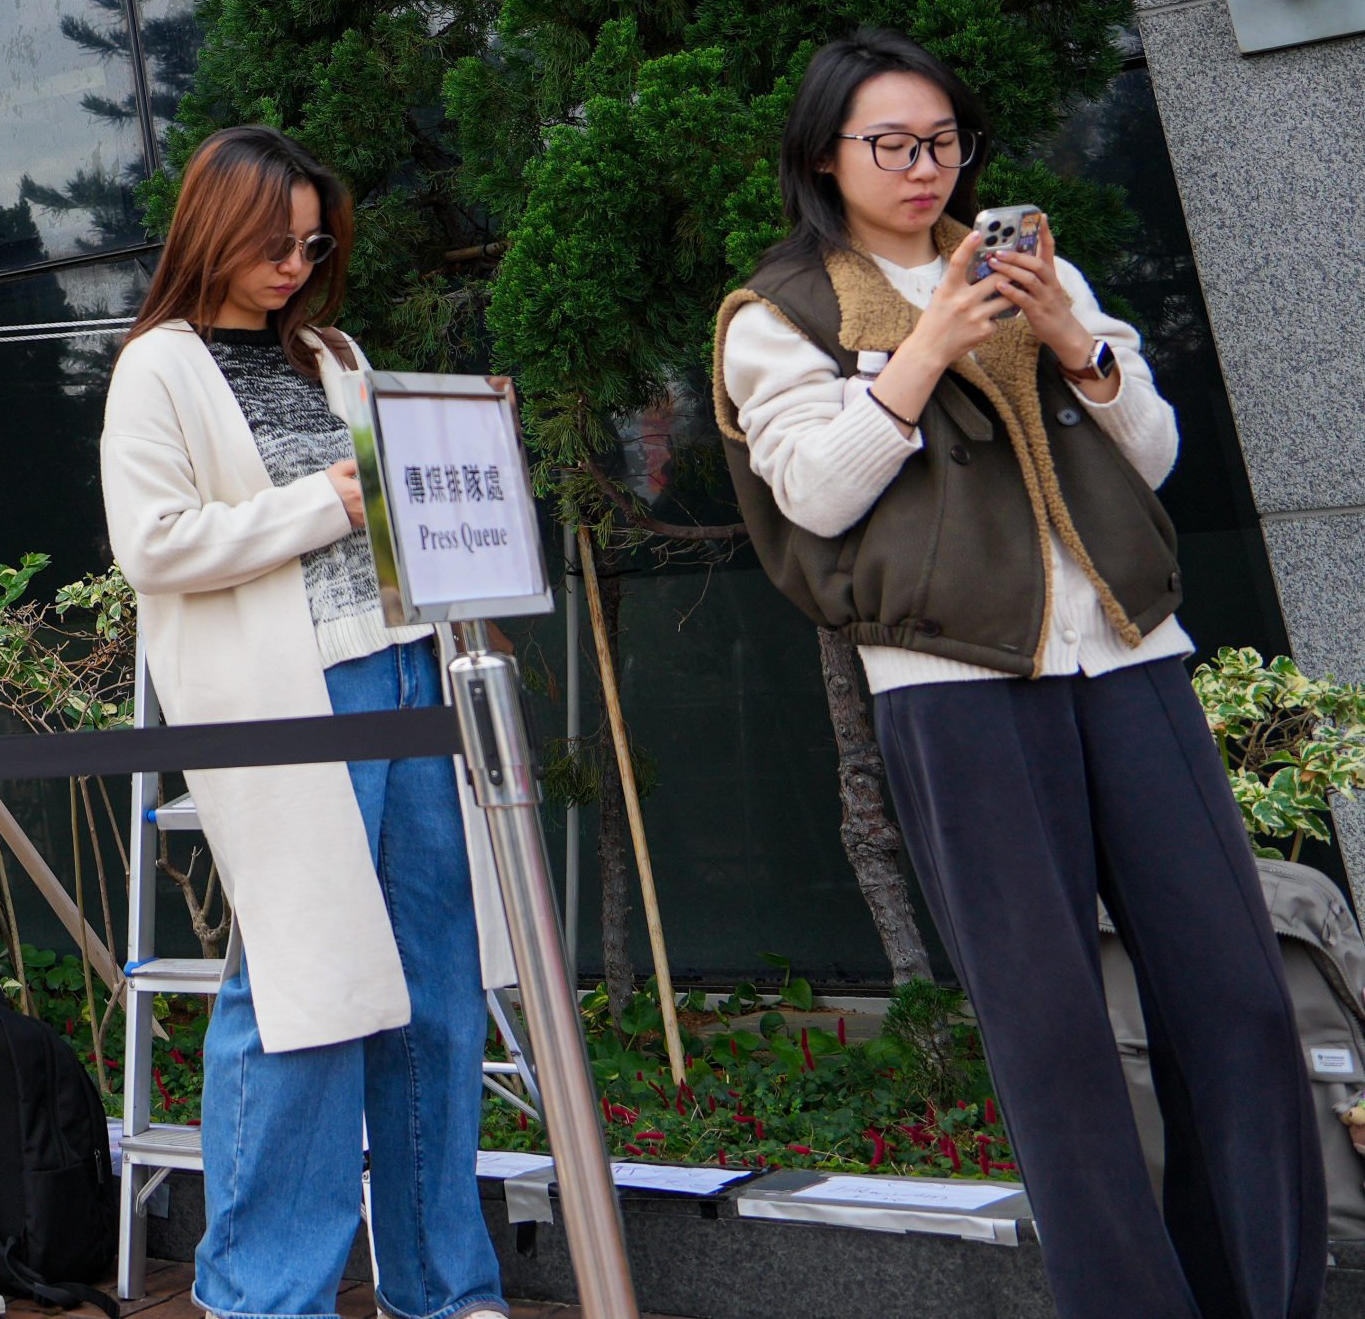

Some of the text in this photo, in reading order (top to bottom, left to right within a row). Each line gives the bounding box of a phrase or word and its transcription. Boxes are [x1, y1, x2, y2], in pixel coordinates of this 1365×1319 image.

[404, 464, 504, 504] 傳媒排隊處
[418, 522, 507, 554] Press Queue
